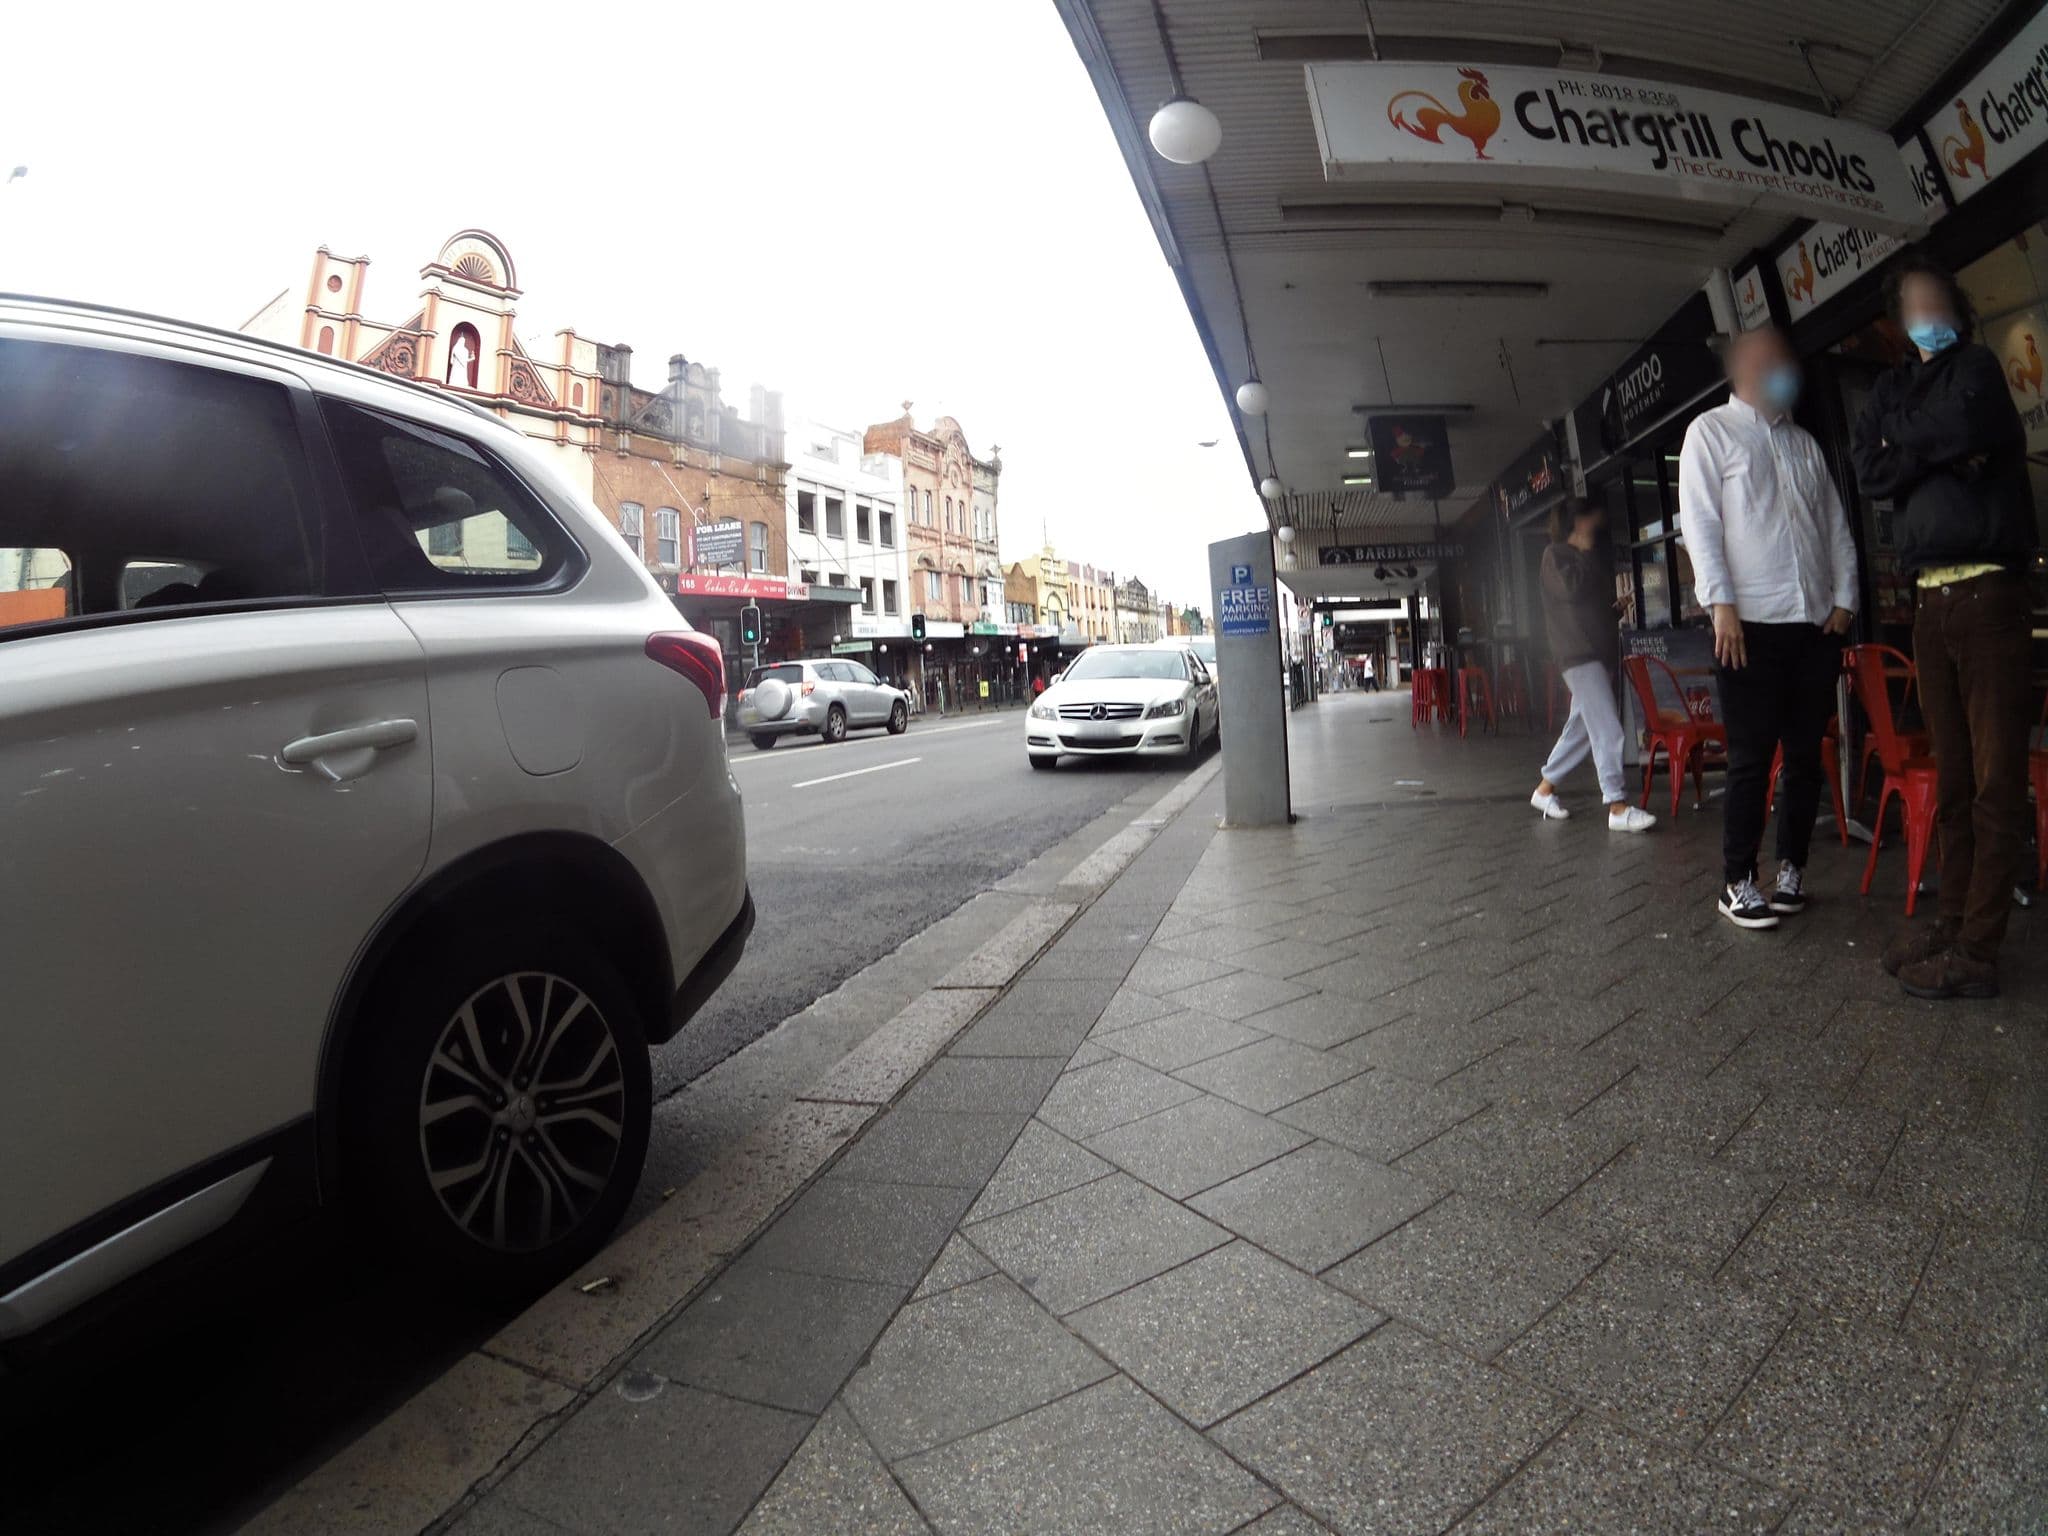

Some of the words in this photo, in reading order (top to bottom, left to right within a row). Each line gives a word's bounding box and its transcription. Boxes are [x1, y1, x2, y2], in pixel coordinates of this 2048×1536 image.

[1558, 79, 1588, 97] PH:
[1590, 82, 1633, 103] 8018
[1514, 88, 1723, 169] Chargrill
[1731, 117, 1876, 193] Chooks
[1668, 155, 1705, 177] The
[1706, 160, 1781, 190] Gourmet
[1782, 175, 1823, 198] Food
[1823, 185, 1885, 214] Paradise
[1618, 353, 1663, 406] TATTOO
[696, 525, 713, 535] FOR
[714, 521, 742, 532] LEASE
[1234, 567, 1248, 585] P
[1220, 587, 1269, 605] FREE
[1221, 603, 1270, 615] PARKING
[1222, 612, 1269, 623] AVAILABLE
[1630, 636, 1665, 646] CHEESE
[1631, 645, 1668, 655] BURGER
